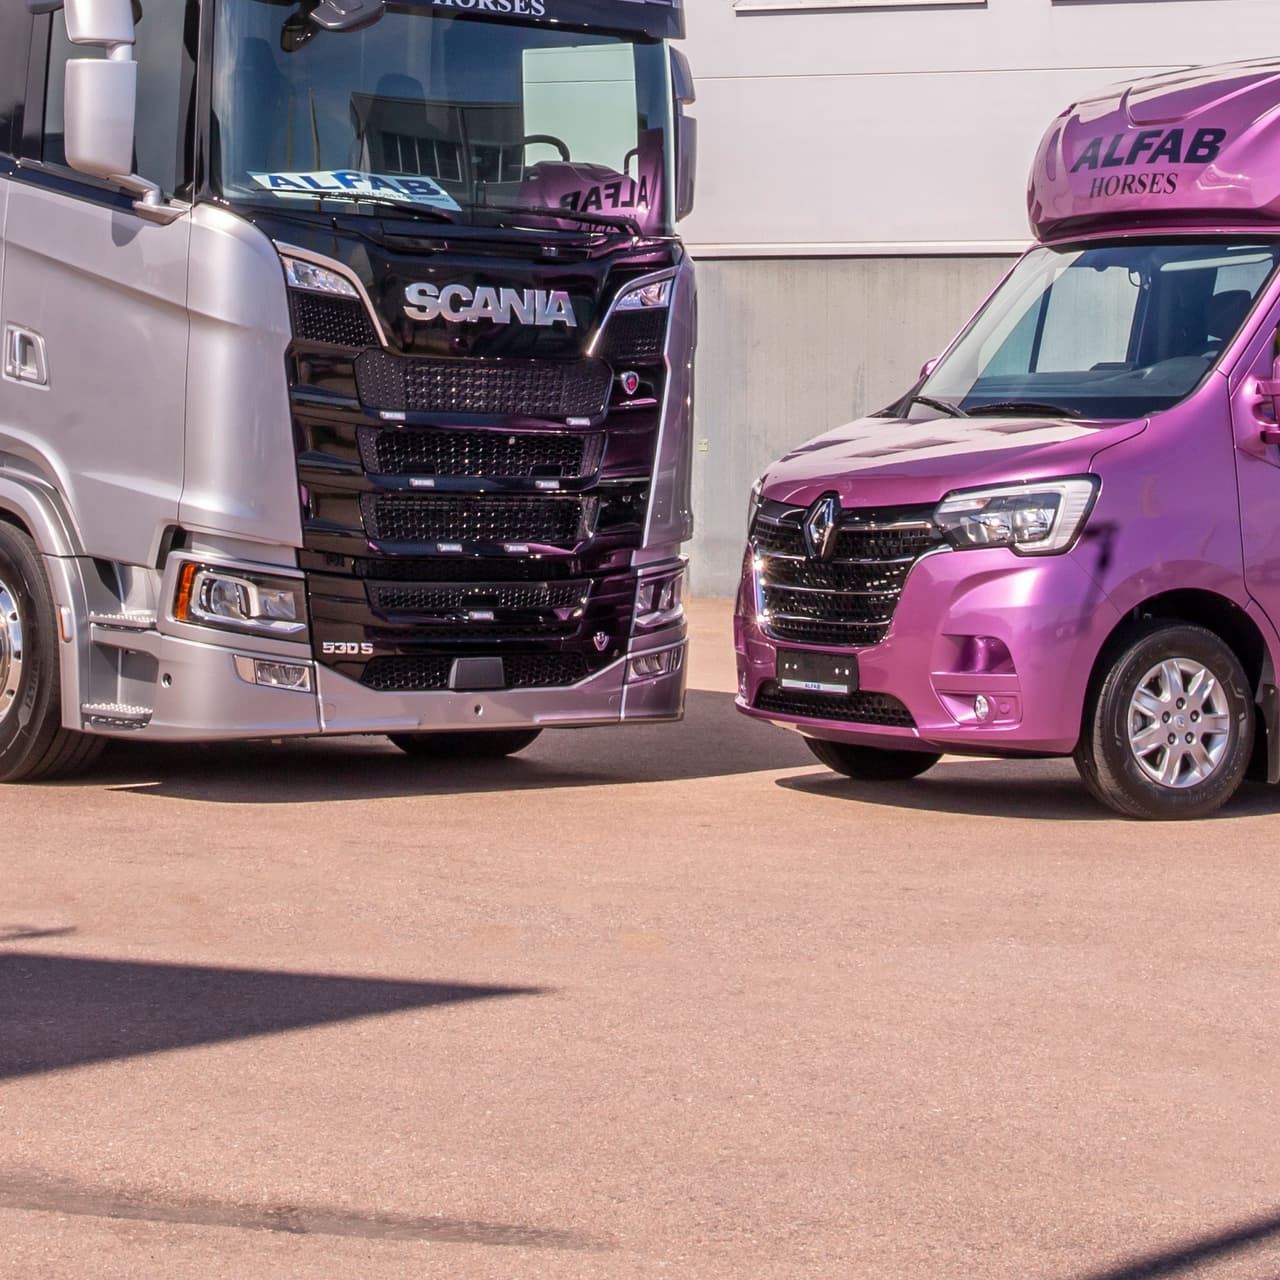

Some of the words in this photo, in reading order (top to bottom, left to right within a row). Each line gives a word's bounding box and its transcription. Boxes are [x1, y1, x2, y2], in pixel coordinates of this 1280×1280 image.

[1070, 127, 1227, 173] ALFAB
[269, 171, 441, 196] ALFAB
[1089, 172, 1179, 199] HORSES
[403, 281, 578, 327] SCANIA
[322, 641, 359, 654] 530
[360, 642, 374, 655] S
